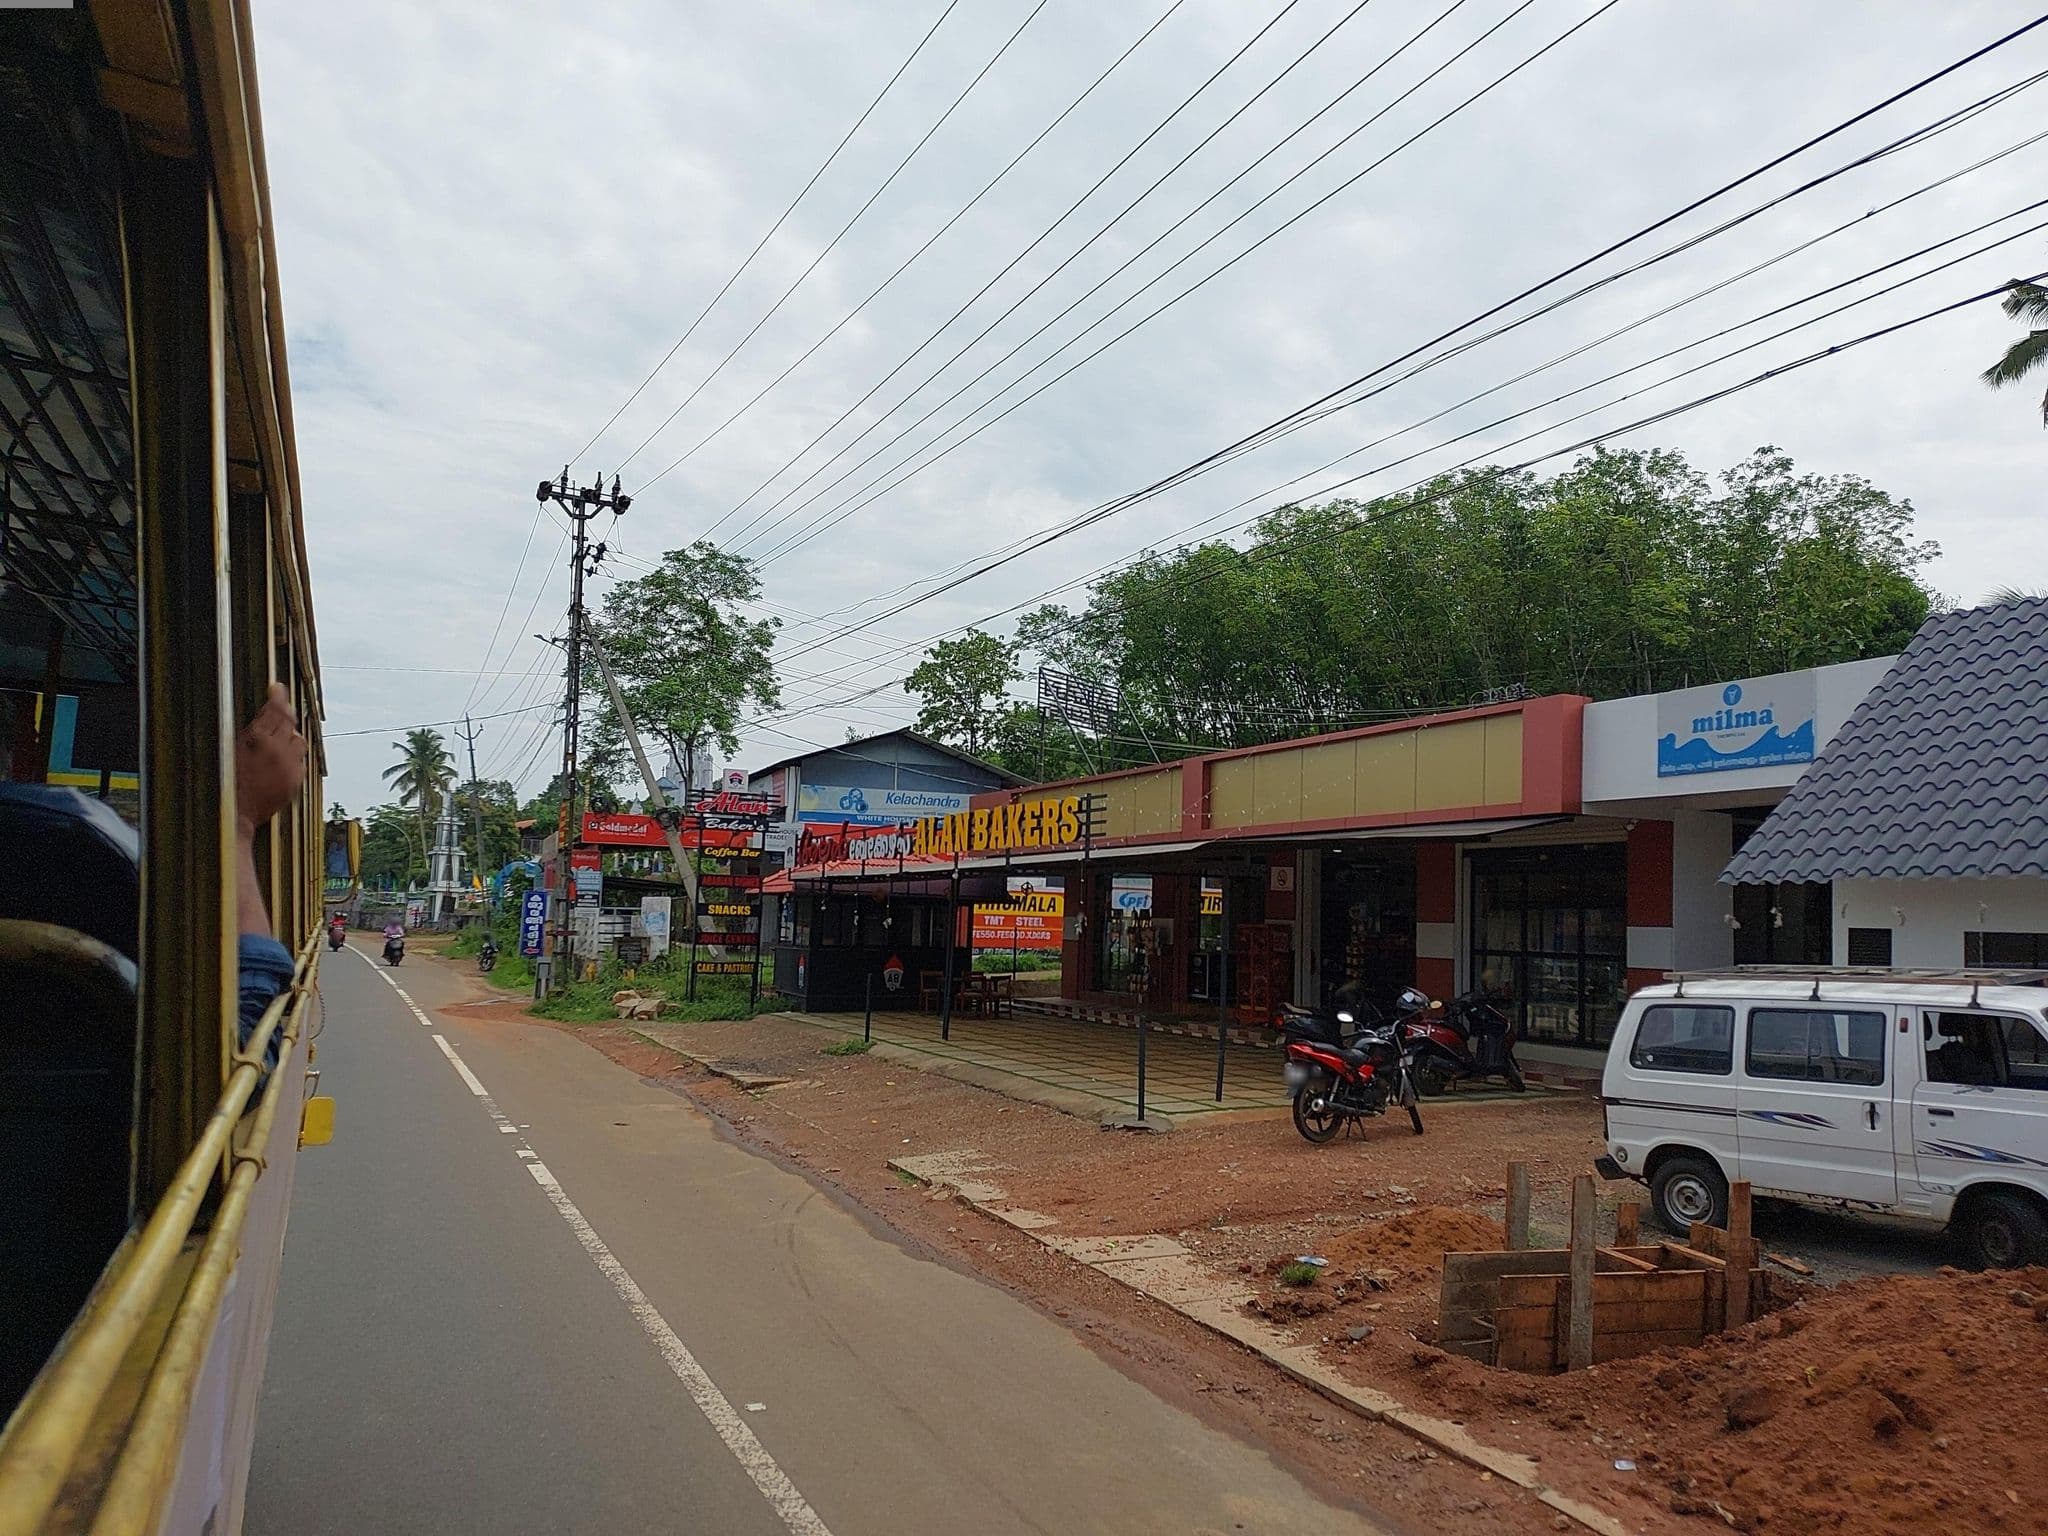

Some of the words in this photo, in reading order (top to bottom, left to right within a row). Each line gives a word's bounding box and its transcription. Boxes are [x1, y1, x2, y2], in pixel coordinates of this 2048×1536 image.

[692, 708, 774, 733] milma
[694, 791, 770, 815] Alan
[885, 791, 961, 808] Kelachandra
[704, 818, 765, 831] Baker's
[914, 812, 970, 856] ALAN
[973, 796, 1081, 851] BAKERS
[704, 847, 738, 857] Coffee
[741, 848, 760, 857] Bar
[708, 904, 751, 915] SNACKS
[984, 916, 1005, 925] TMT
[1016, 917, 1045, 927] STEEL
[697, 963, 715, 973] CAKE
